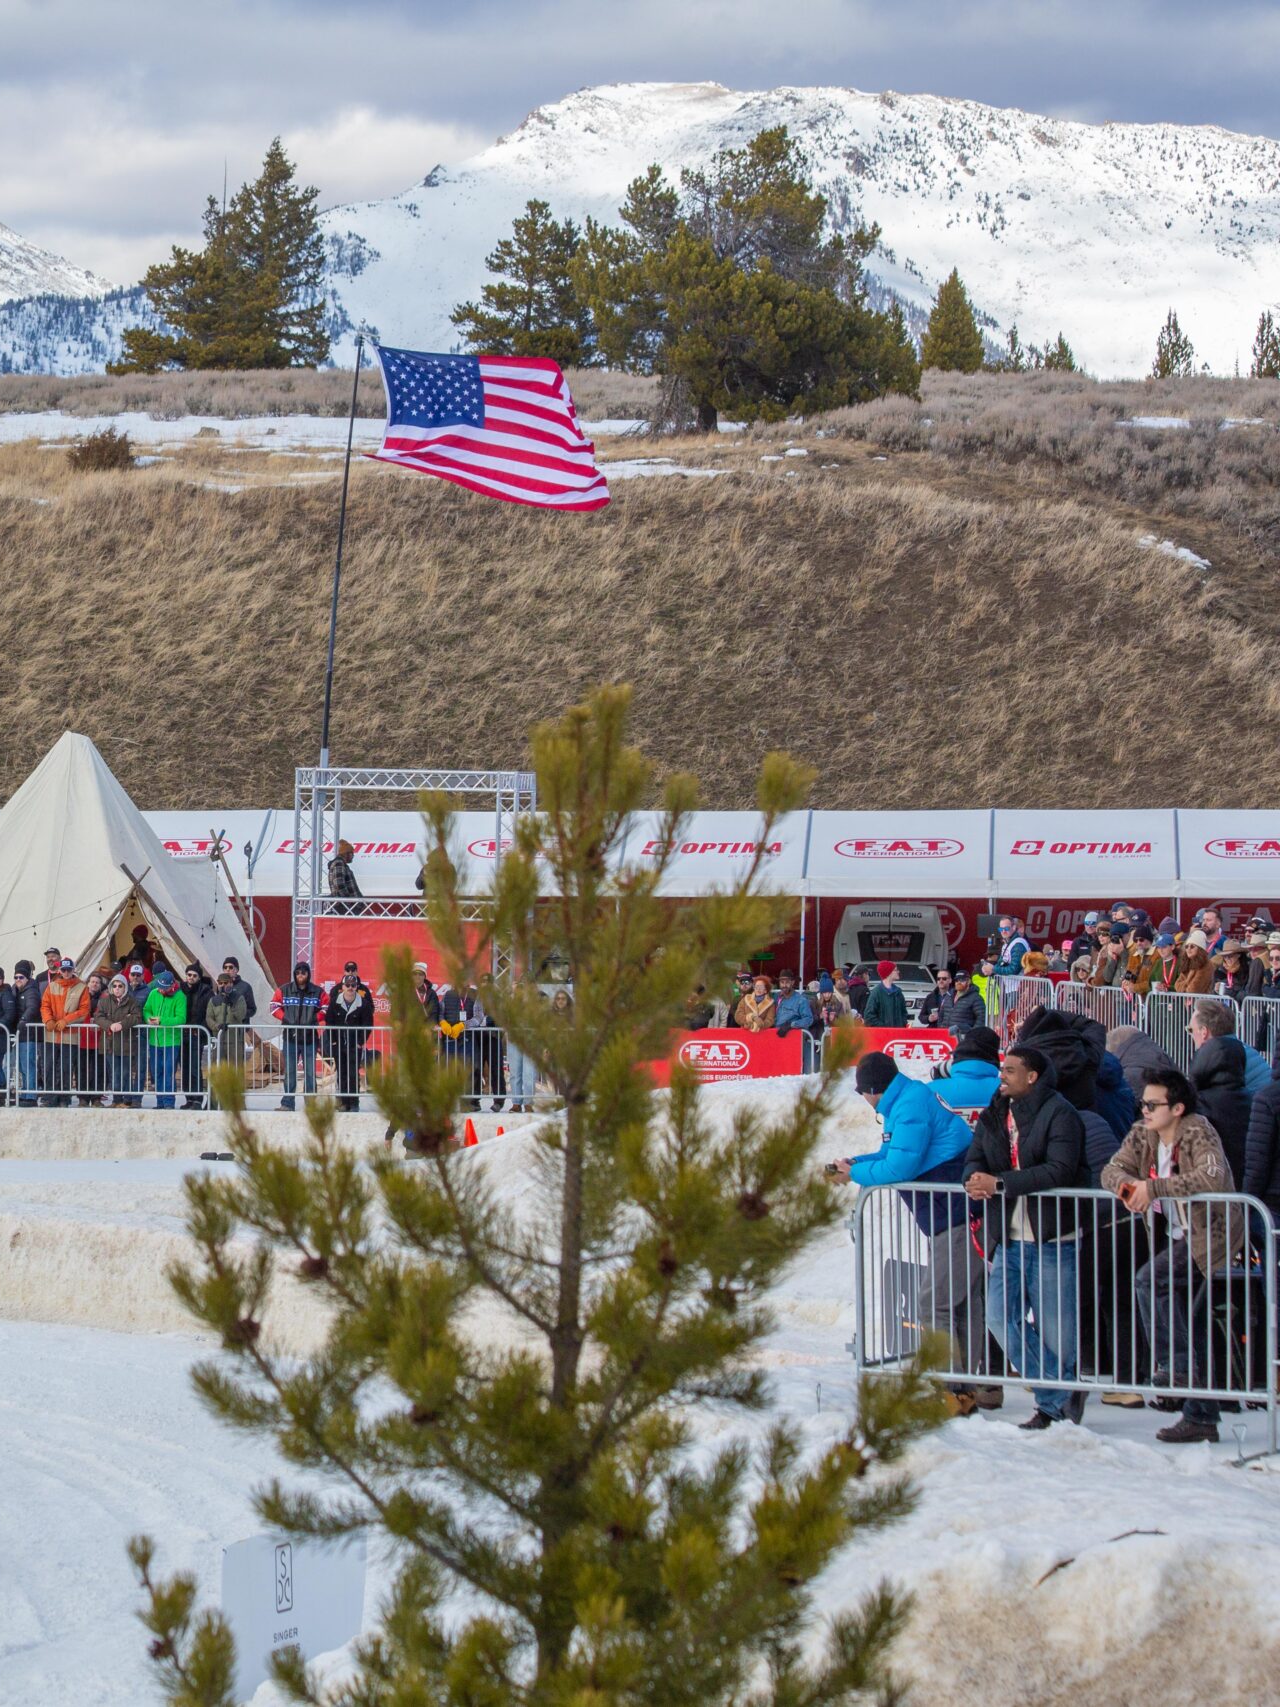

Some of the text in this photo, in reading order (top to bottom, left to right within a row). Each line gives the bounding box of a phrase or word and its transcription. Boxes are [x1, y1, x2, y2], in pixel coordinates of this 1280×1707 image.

[1049, 842, 1152, 854] OPTIMA
[892, 911, 922, 919] RACING
[273, 1627, 299, 1643] SINGER
